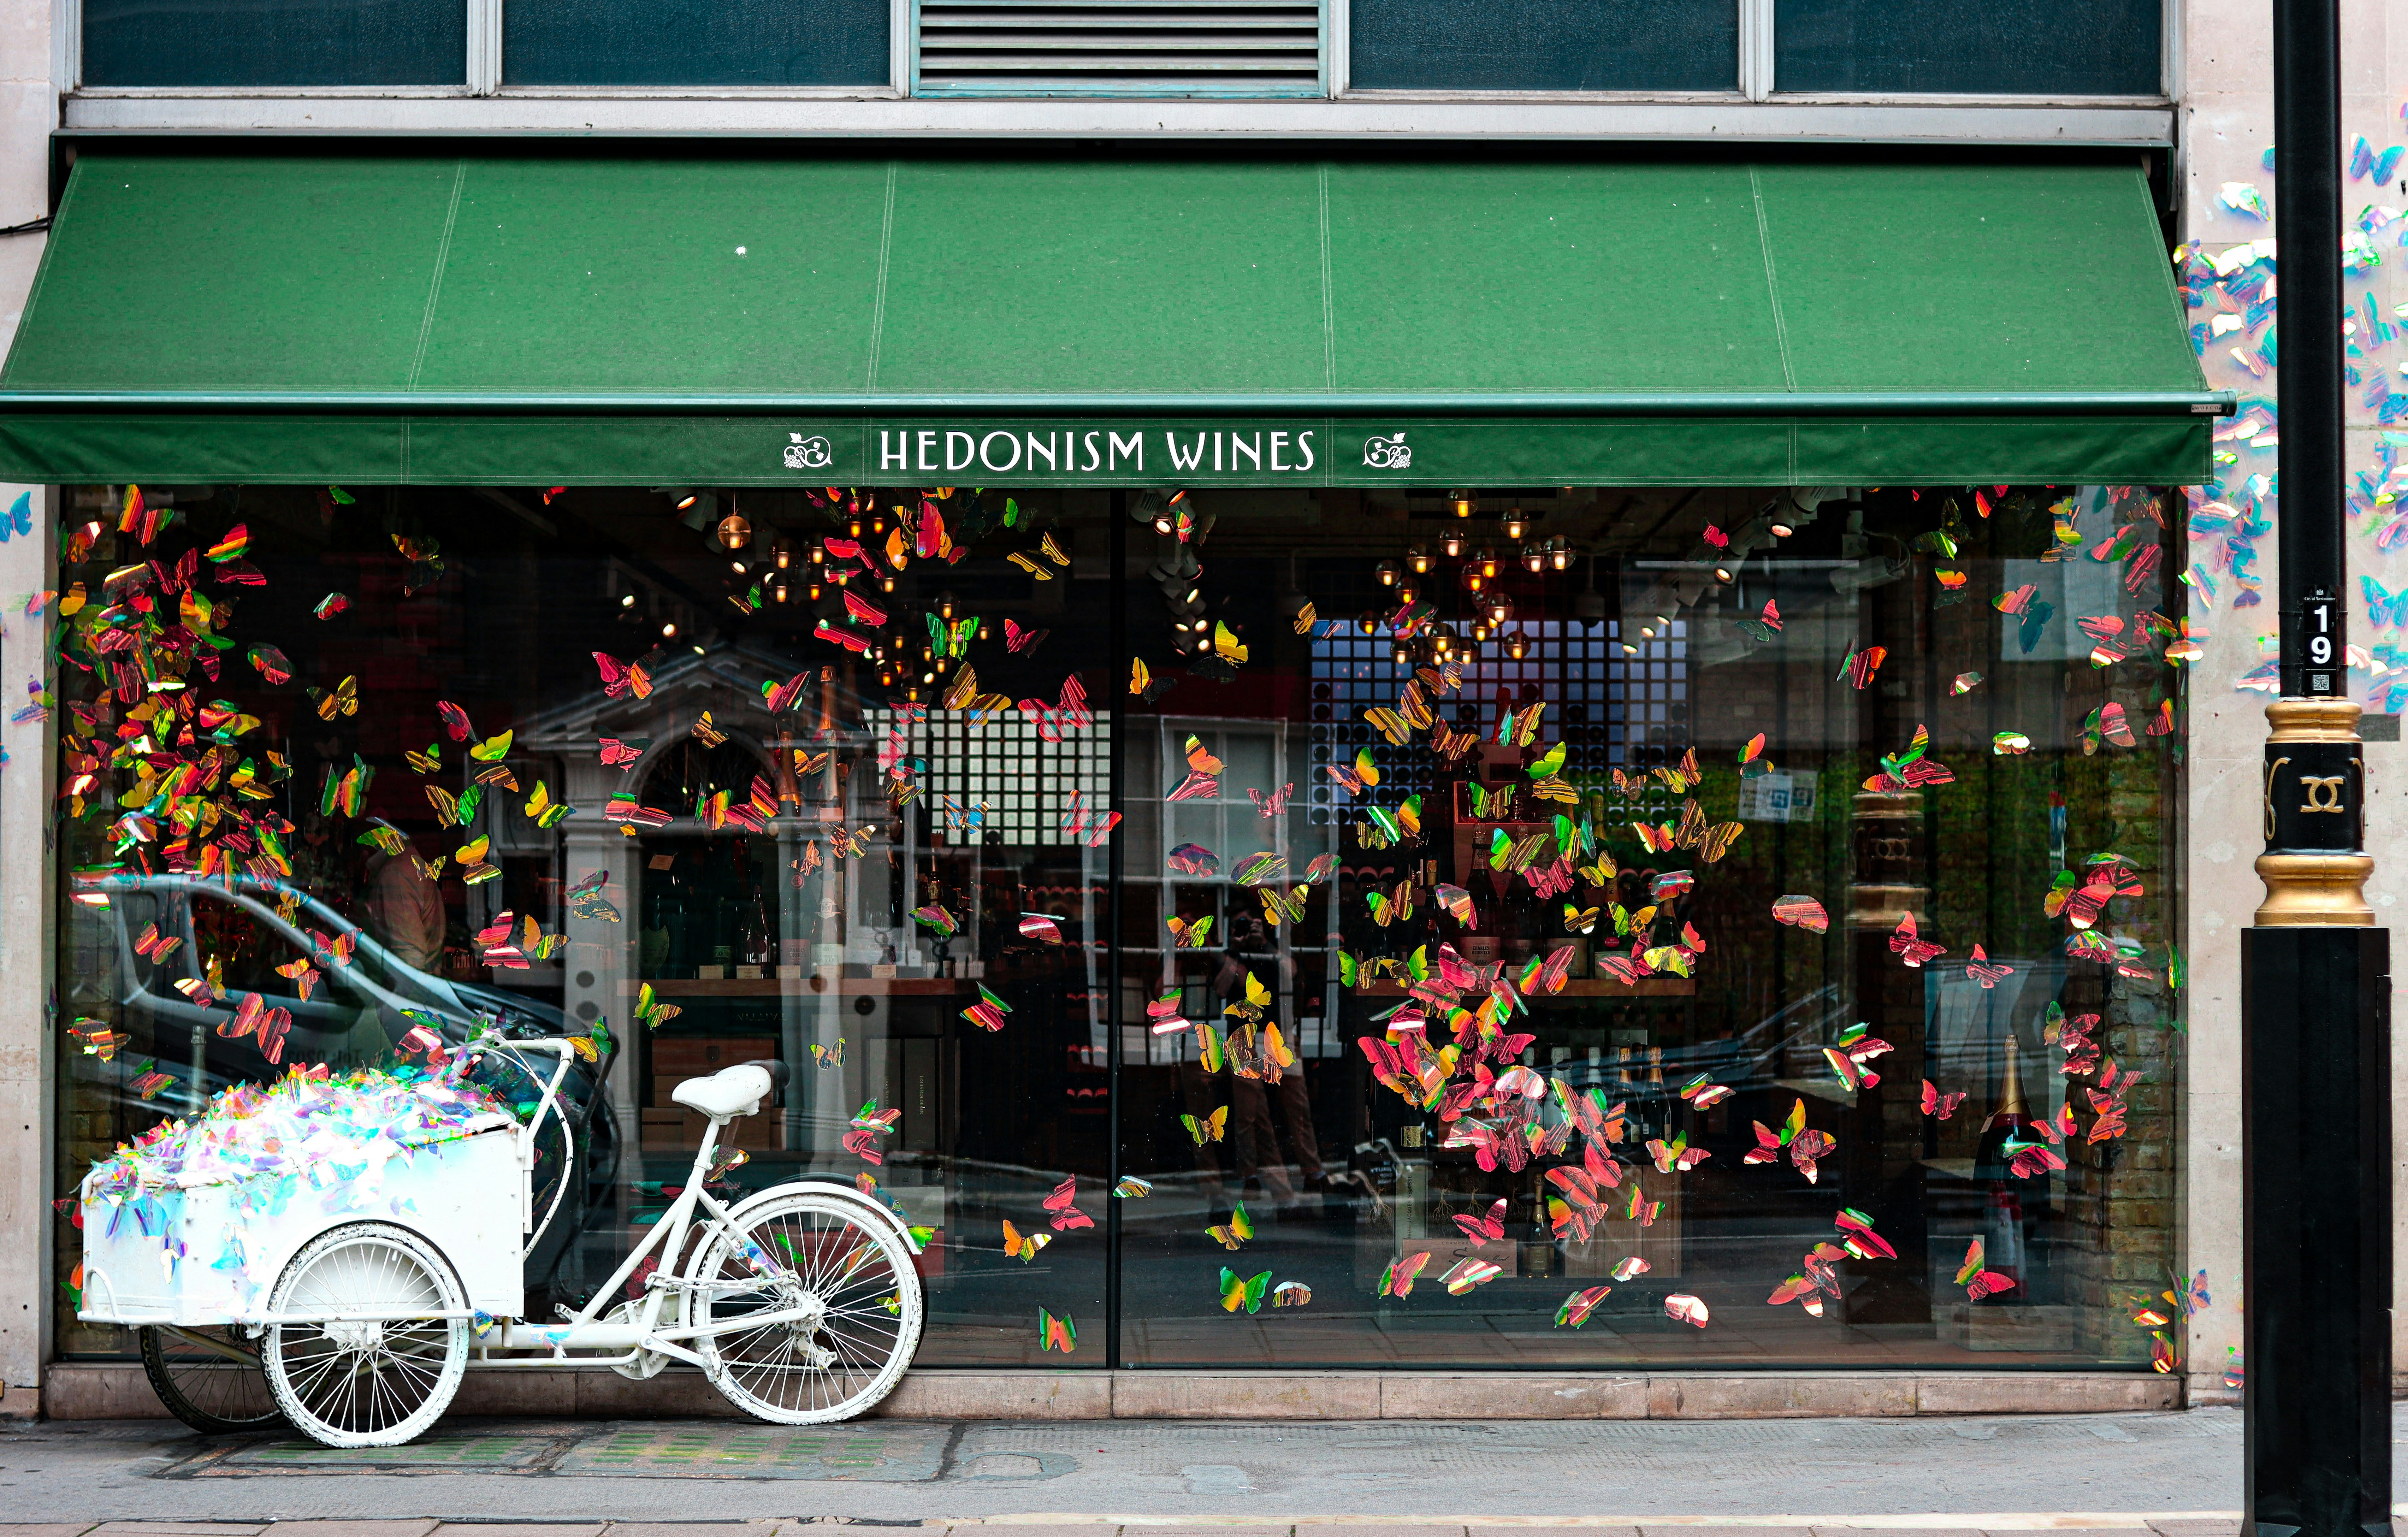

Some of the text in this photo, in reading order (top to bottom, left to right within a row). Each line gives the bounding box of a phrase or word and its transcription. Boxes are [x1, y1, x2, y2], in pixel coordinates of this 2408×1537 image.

[882, 431, 1314, 471] HEDONISM WINES
[2314, 605, 2327, 632] 1
[2311, 636, 2331, 664] 9
